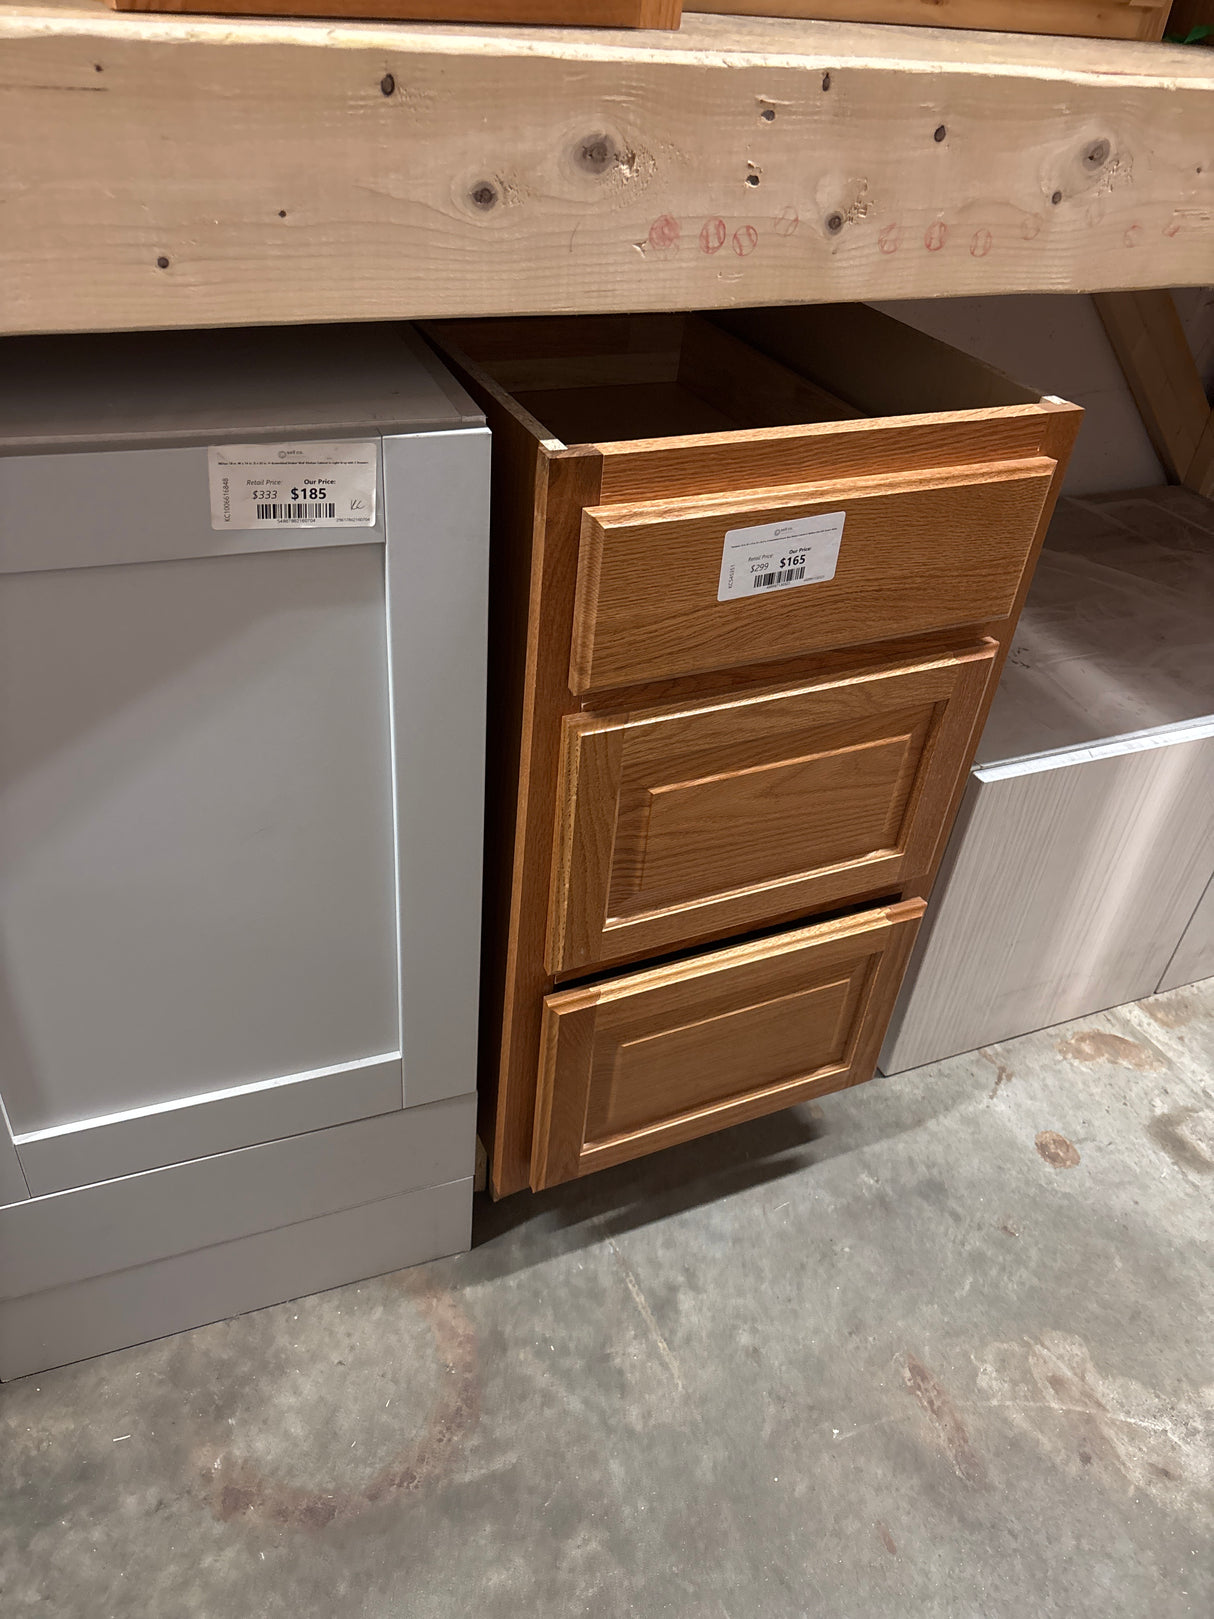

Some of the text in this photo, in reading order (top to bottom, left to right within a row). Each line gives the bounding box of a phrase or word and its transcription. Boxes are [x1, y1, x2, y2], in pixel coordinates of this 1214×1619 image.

[252, 489, 278, 500] $333
[290, 486, 328, 501] $185
[750, 562, 769, 573] $299
[779, 554, 806, 569] $165
